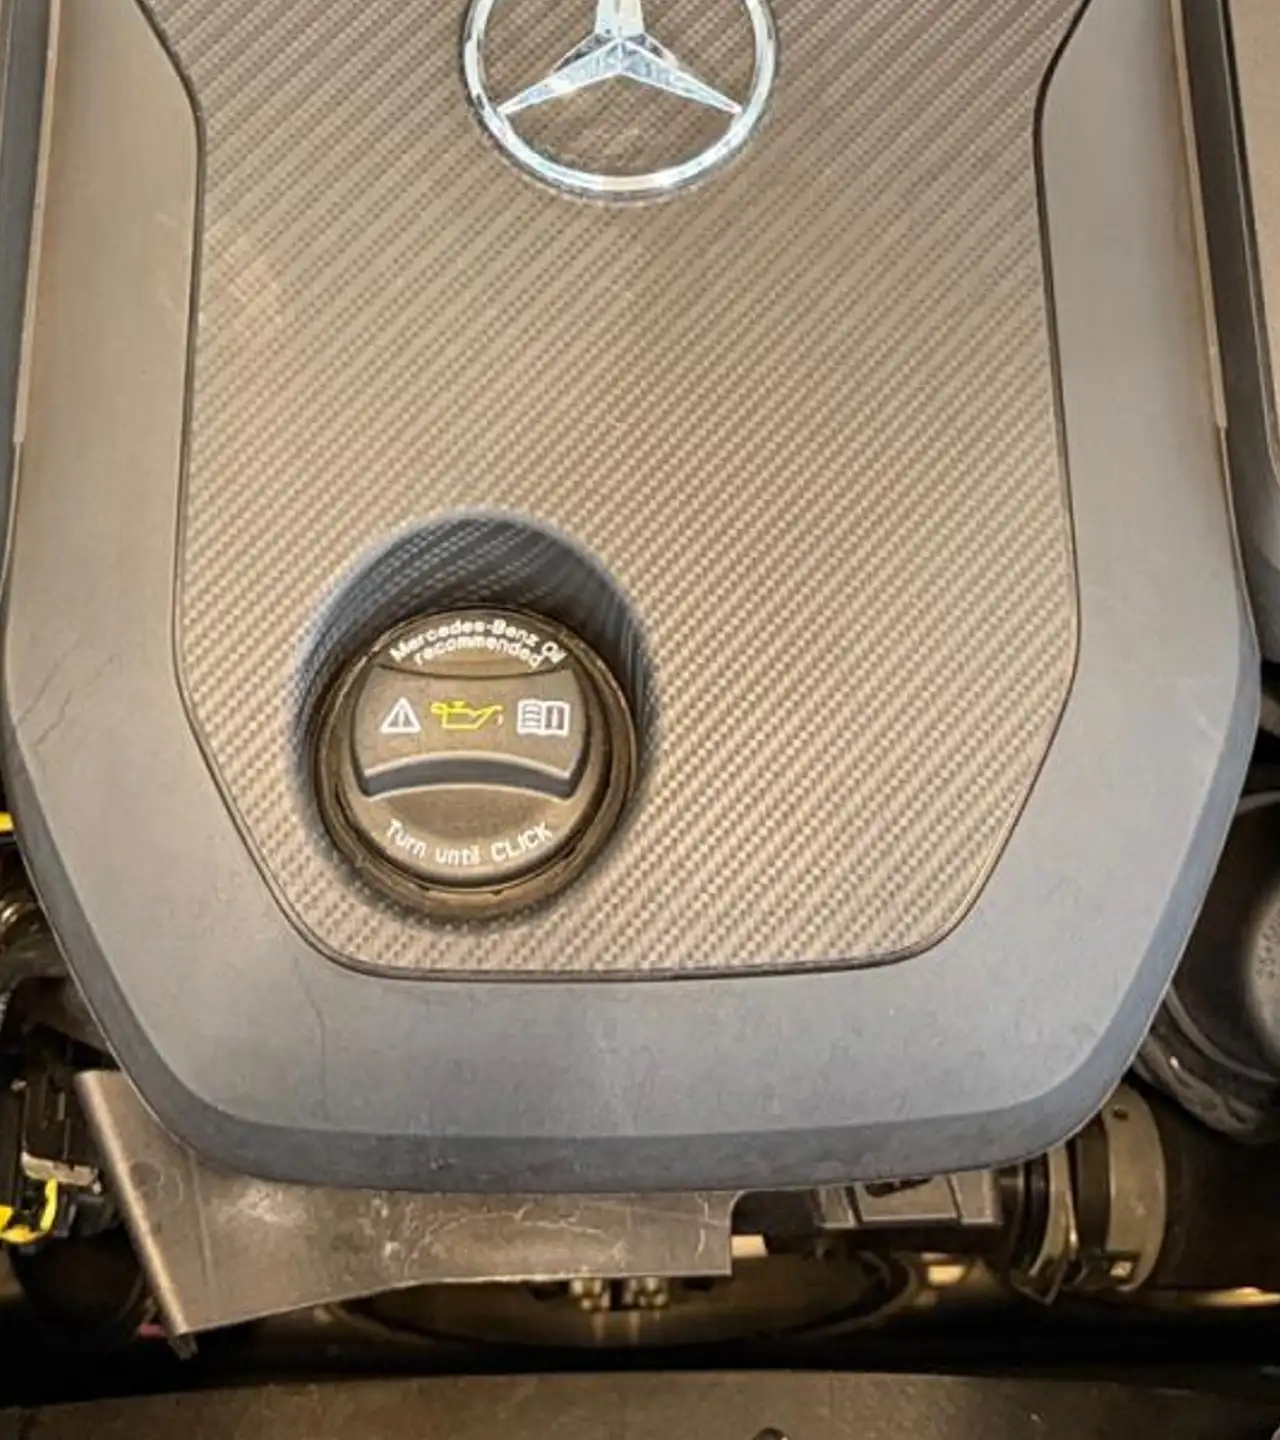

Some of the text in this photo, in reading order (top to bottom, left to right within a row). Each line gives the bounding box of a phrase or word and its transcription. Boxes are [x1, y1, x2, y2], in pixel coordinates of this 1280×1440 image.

[389, 618, 540, 662] Mercedes-Benz
[413, 634, 543, 668] recommended
[386, 818, 554, 866] Turn until CLICK
